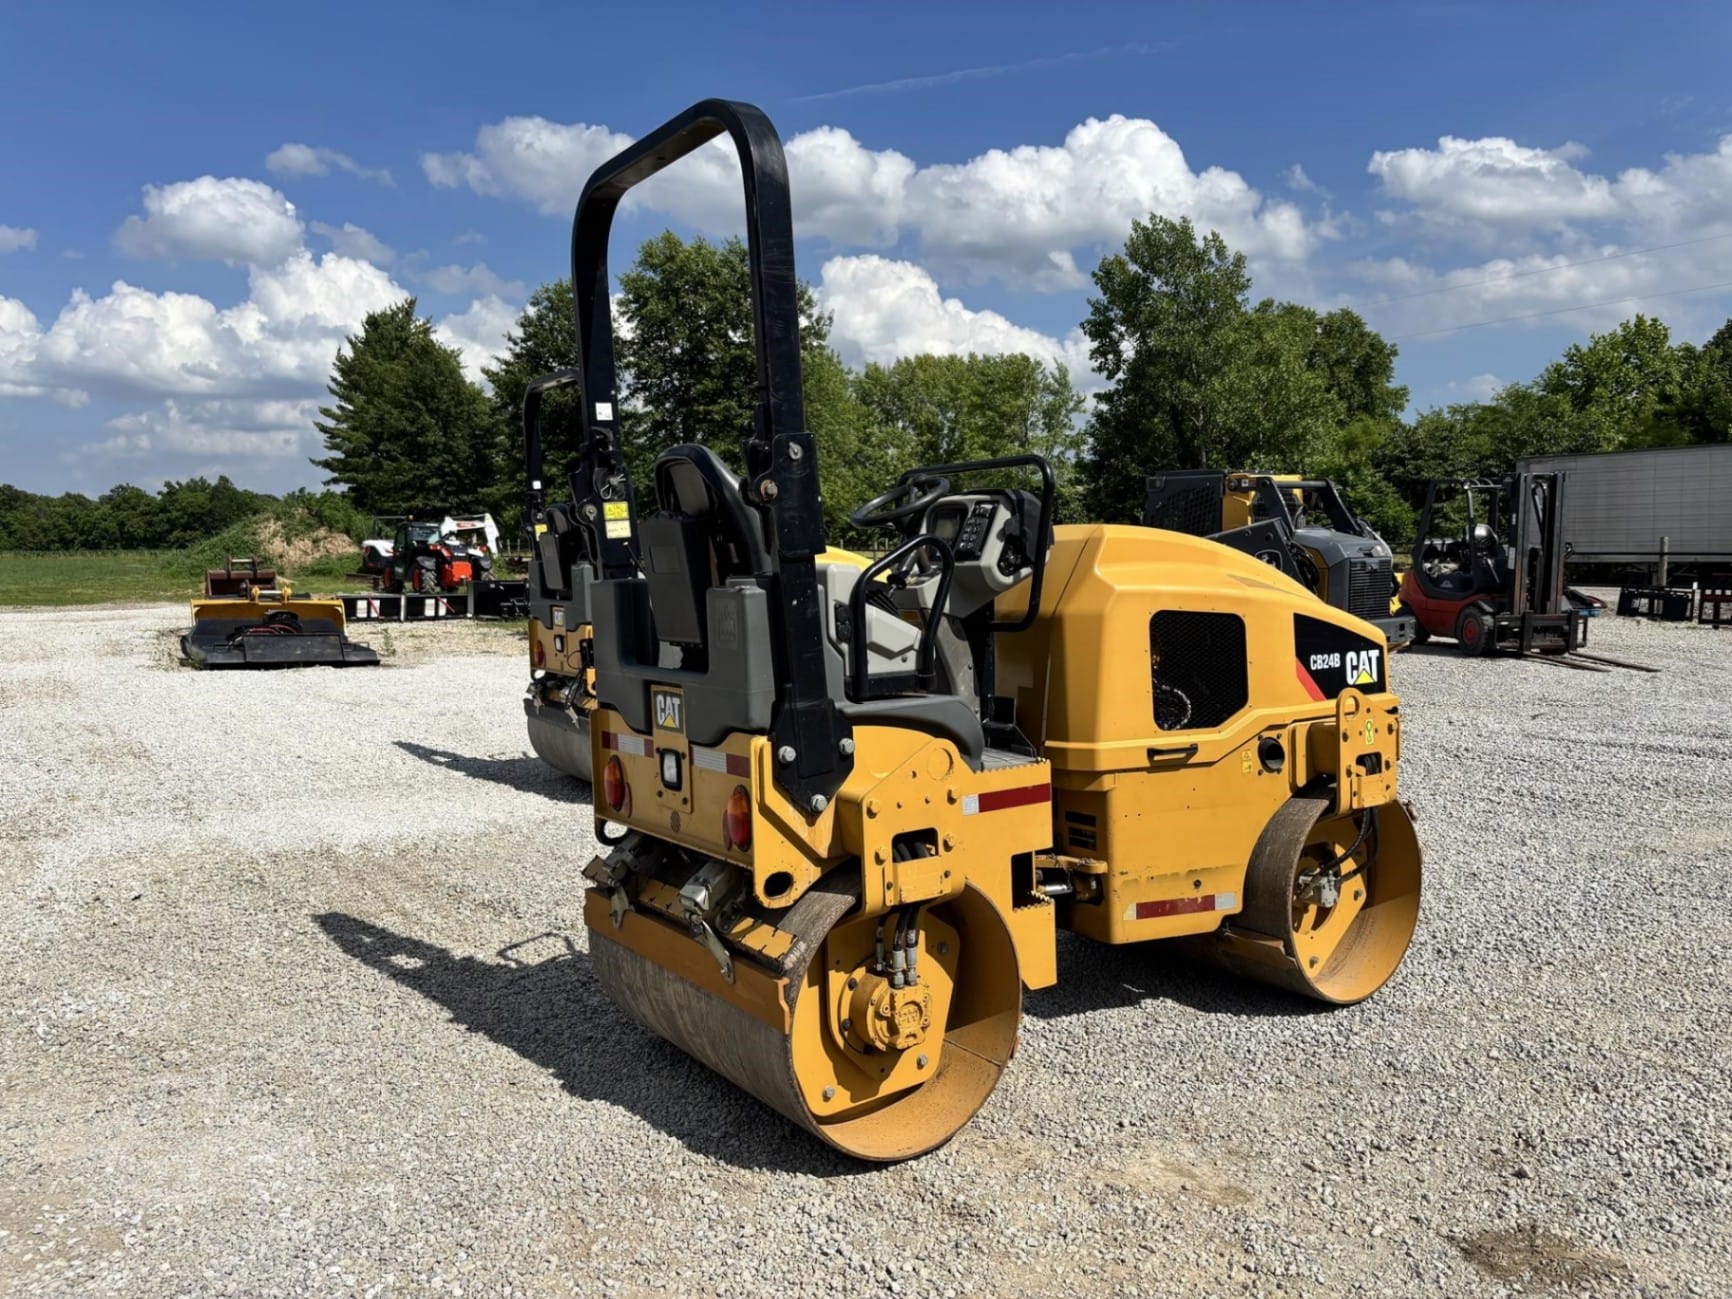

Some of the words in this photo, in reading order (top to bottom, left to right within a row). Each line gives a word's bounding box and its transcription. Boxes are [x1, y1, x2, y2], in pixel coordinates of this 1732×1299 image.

[1310, 653, 1341, 670] CB24B
[1345, 649, 1379, 685] CAT
[656, 694, 680, 729] CAT
